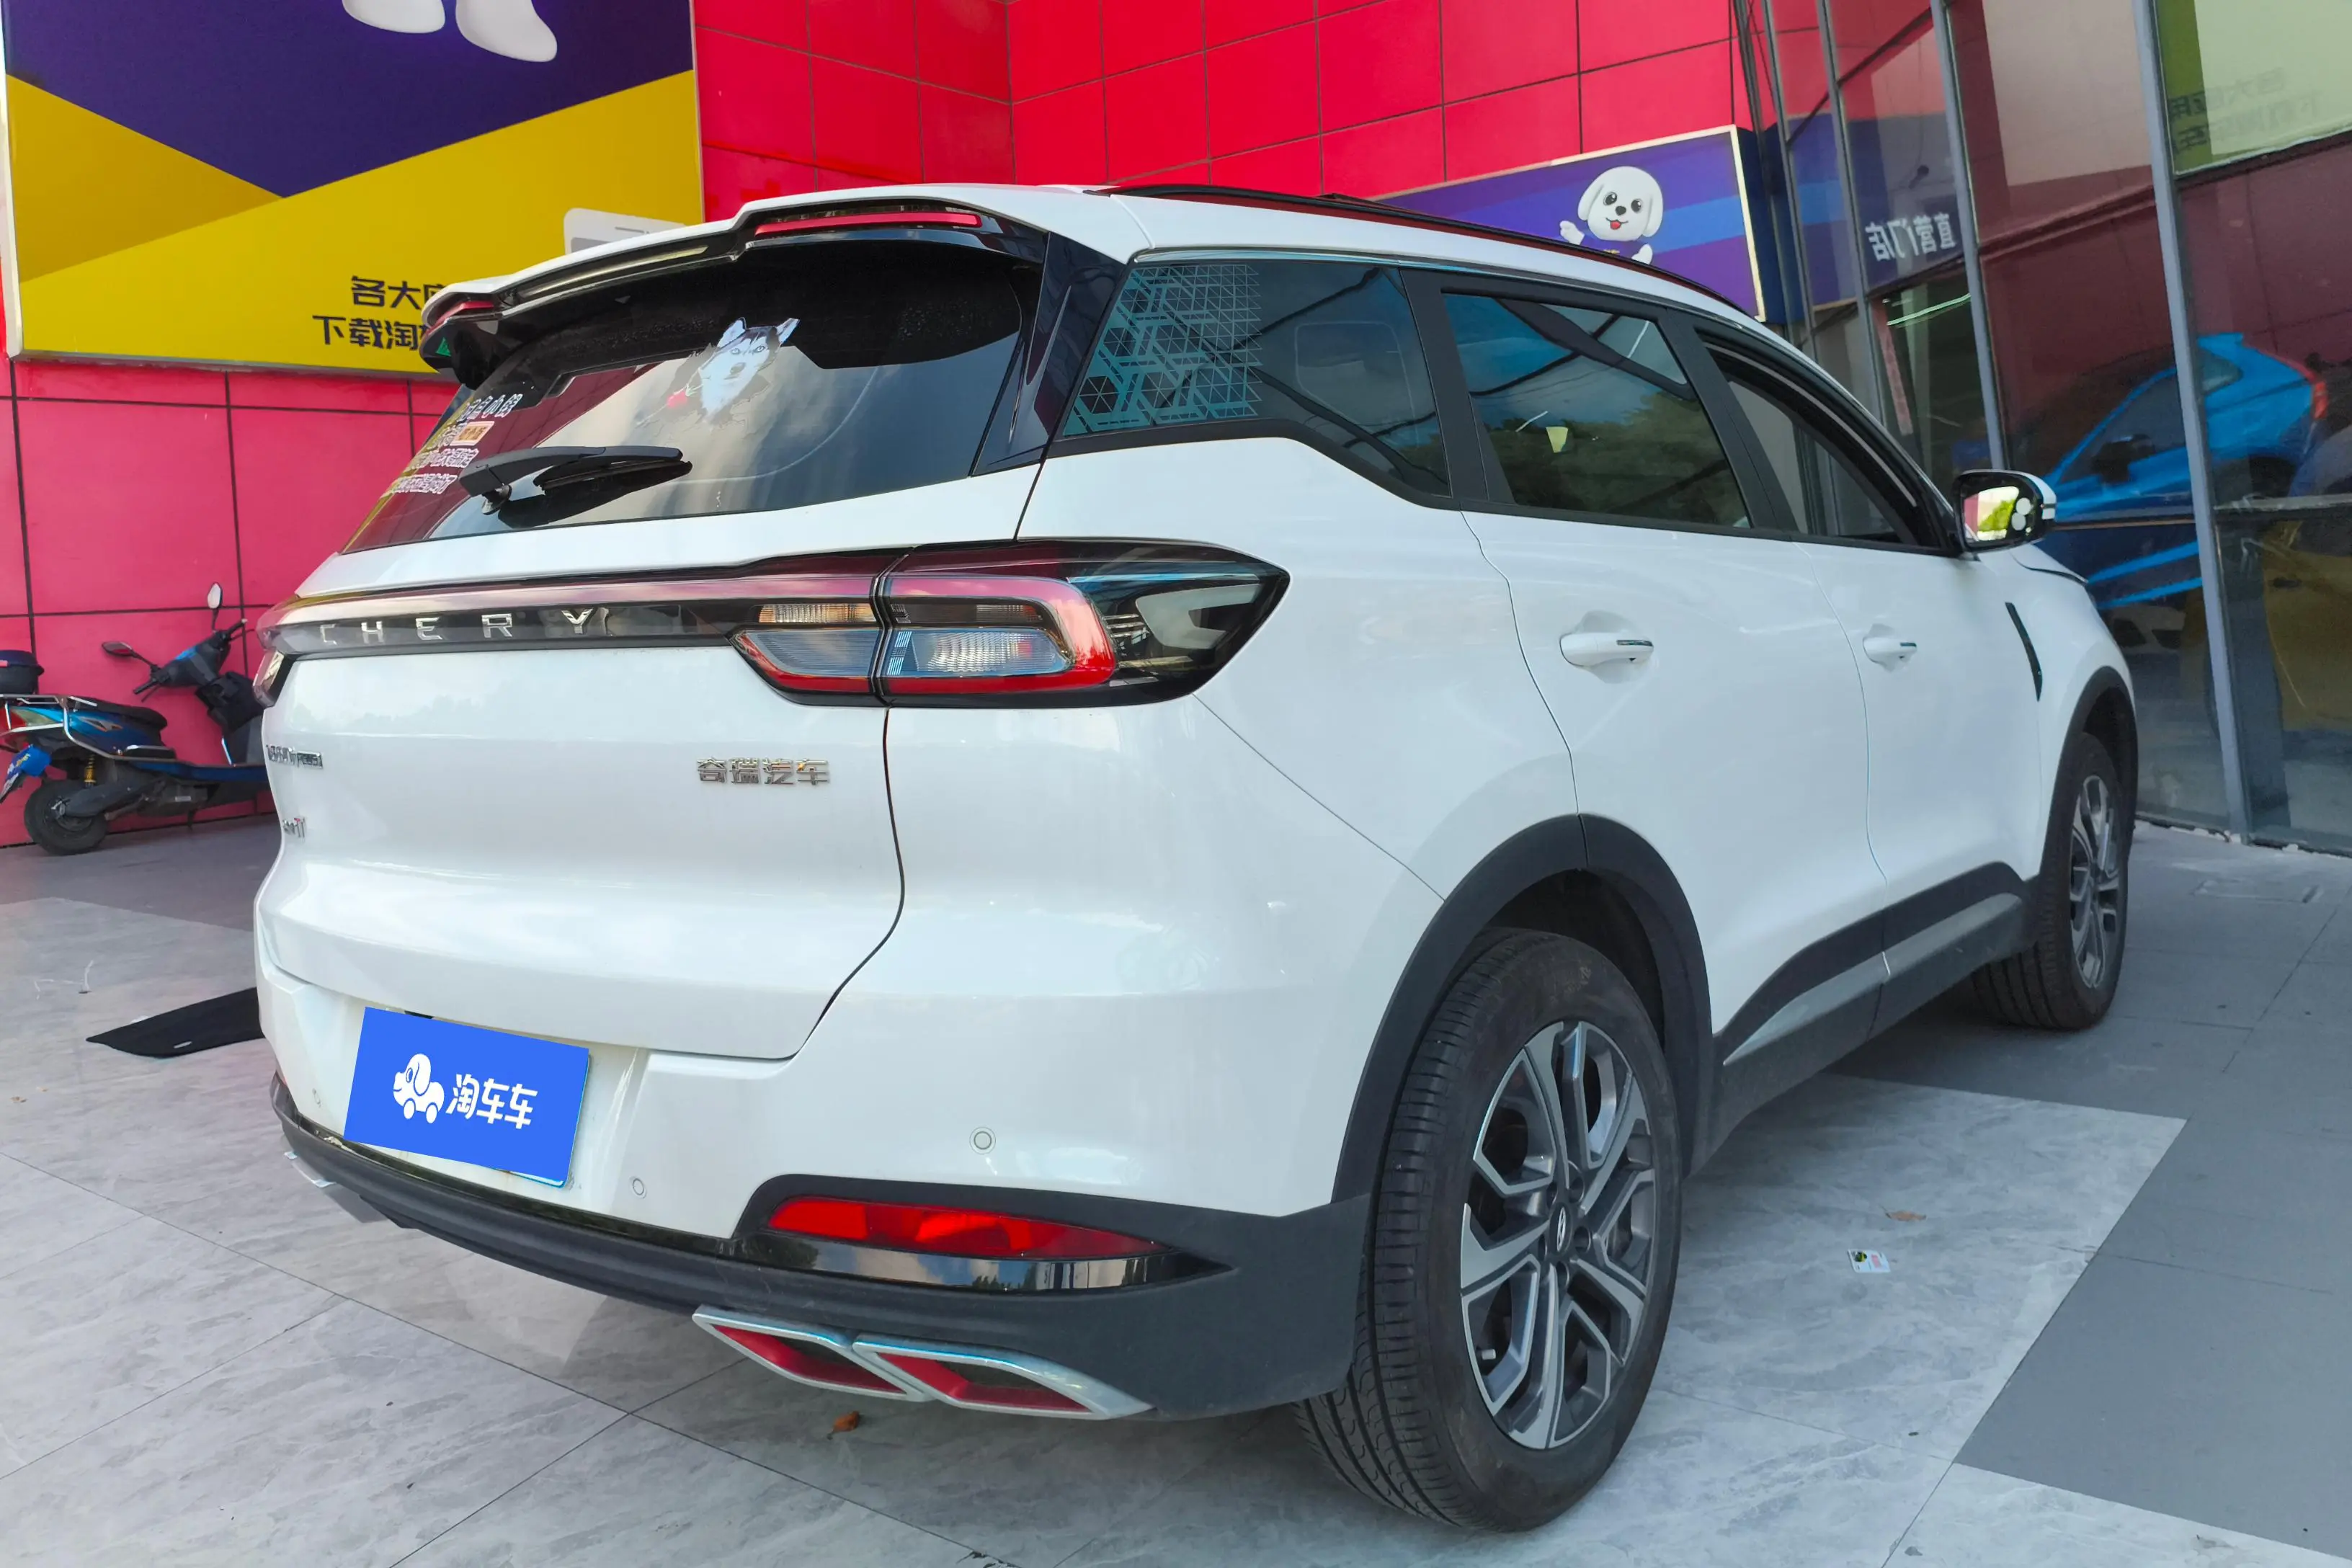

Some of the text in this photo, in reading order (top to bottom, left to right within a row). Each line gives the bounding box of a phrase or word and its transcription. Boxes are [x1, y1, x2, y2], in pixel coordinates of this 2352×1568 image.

[312, 315, 429, 351] 下载淘
[319, 607, 594, 646] CHERY
[697, 757, 829, 785] 奇瑞汽车
